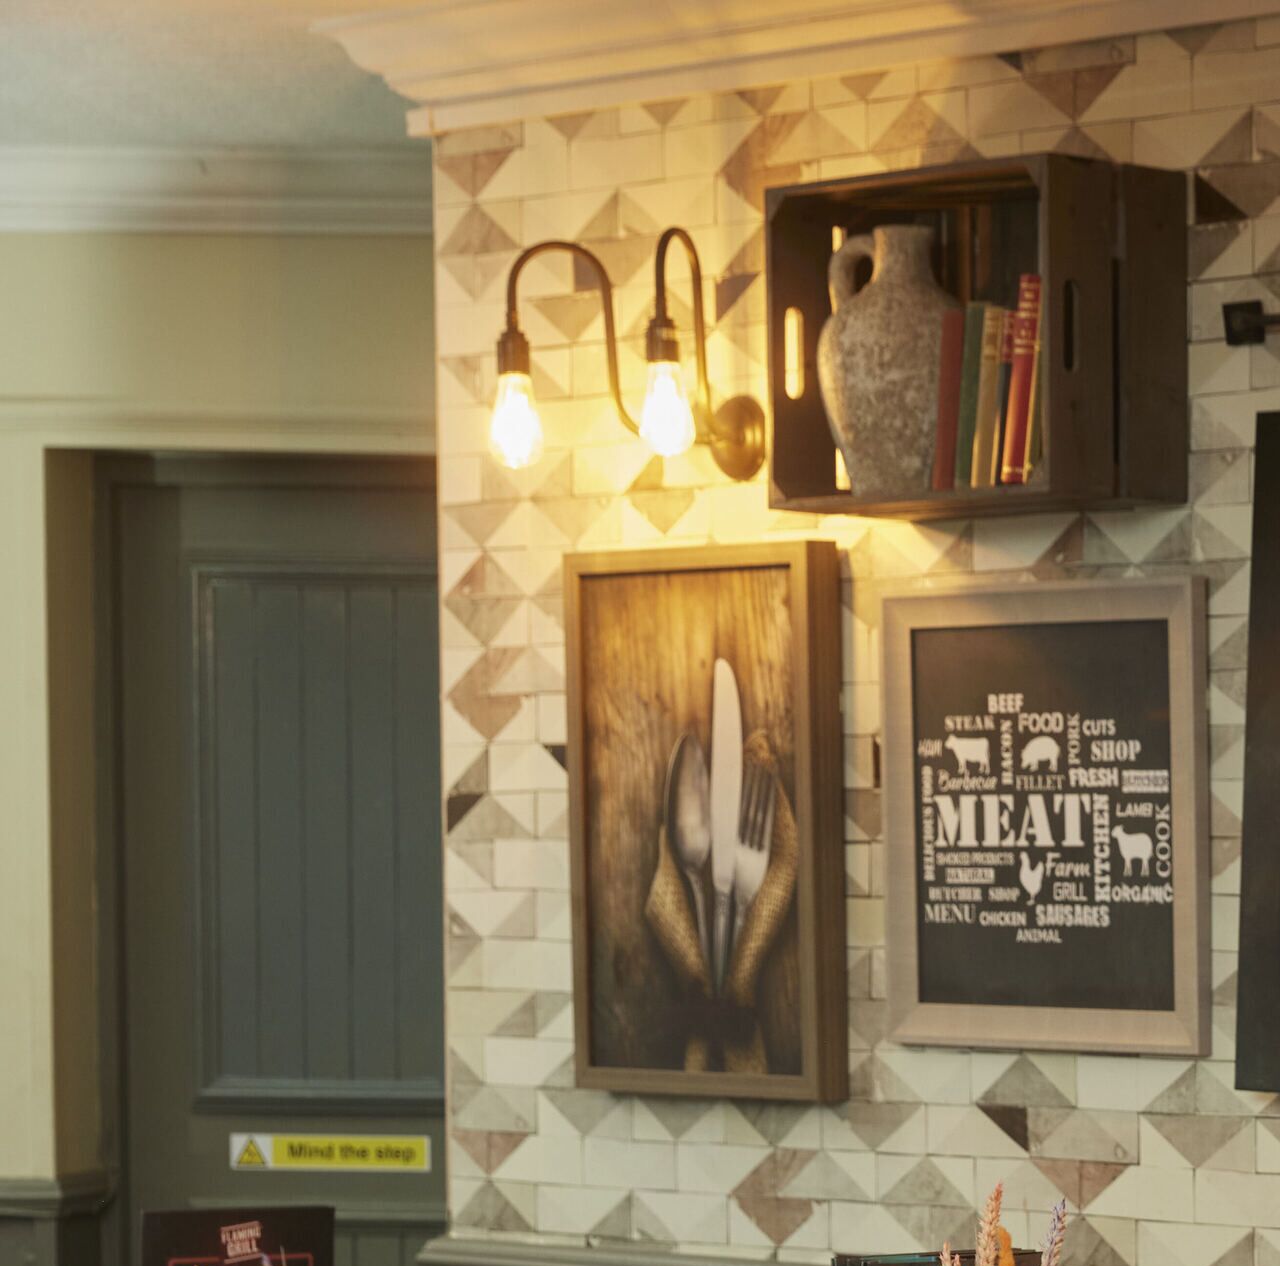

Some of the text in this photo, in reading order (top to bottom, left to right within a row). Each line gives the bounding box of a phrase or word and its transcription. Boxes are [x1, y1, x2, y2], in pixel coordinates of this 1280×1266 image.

[988, 693, 1023, 714] BEEF
[944, 715, 995, 731] STEAK
[1018, 712, 1063, 733] FOOD
[1082, 719, 1116, 736] CUTS
[1067, 712, 1080, 765] PORK
[1001, 719, 1013, 785] BACON
[1091, 740, 1141, 762] SHOP
[937, 769, 998, 792] Barbecue
[1016, 774, 1065, 791] FILLET
[1068, 767, 1118, 787] FRESH
[1116, 802, 1153, 817] LAMB
[933, 793, 1092, 848] MEAT
[1092, 793, 1111, 902] KITCHEN
[1155, 803, 1171, 878] COOK
[1045, 852, 1091, 877] Farm
[1053, 882, 1088, 901] GRILL
[1111, 882, 1173, 904] ORGANIC
[924, 903, 976, 924] MENU
[979, 911, 1027, 927] CHICKEN
[1036, 904, 1110, 927] SAUSAGES
[1016, 928, 1062, 943] ANIMAL
[287, 1142, 416, 1166] Mind the step
